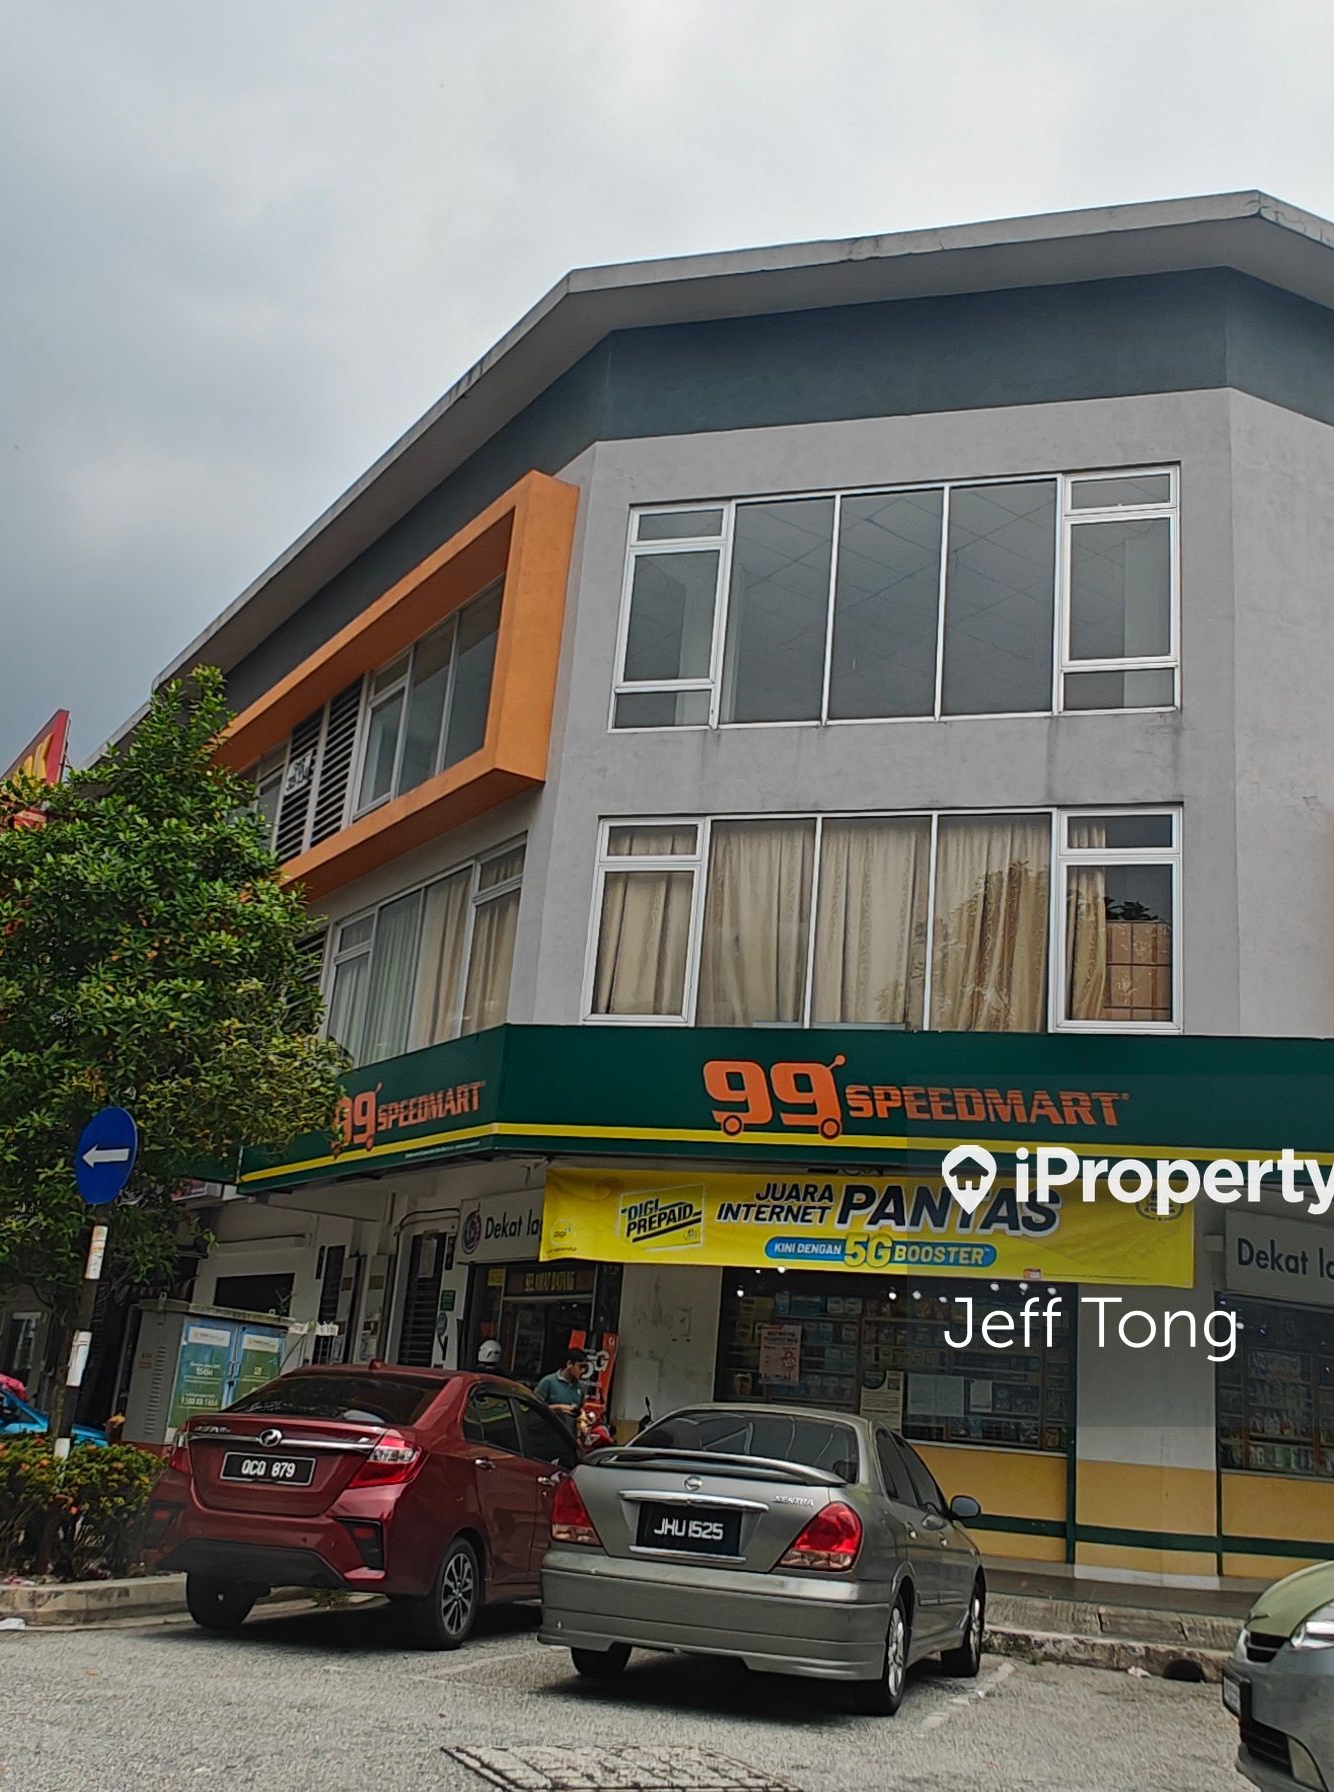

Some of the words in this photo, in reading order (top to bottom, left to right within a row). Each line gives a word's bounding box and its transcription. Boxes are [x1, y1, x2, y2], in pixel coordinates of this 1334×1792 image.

[703, 1054, 846, 1140] 99
[845, 1085, 1120, 1126] SPEEDMART
[331, 1082, 382, 1160] 99
[378, 1083, 481, 1131] SPEEDMART
[755, 1183, 834, 1203] JUARA
[836, 1183, 1064, 1235] PANAS
[484, 1211, 523, 1240] Dekat
[526, 1208, 543, 1238] la
[626, 1203, 695, 1239] PREPAID
[627, 1198, 660, 1222] DIGI
[716, 1202, 832, 1225] INTERNET
[774, 1243, 796, 1254] KINI
[797, 1243, 842, 1256] DENGAN
[843, 1231, 895, 1268] 5G
[894, 1243, 986, 1266] BOOSTER
[1237, 1237, 1308, 1275] Dekat
[270, 1461, 296, 1478] 879
[653, 1517, 686, 1537] JHU
[688, 1519, 724, 1541] 1525
